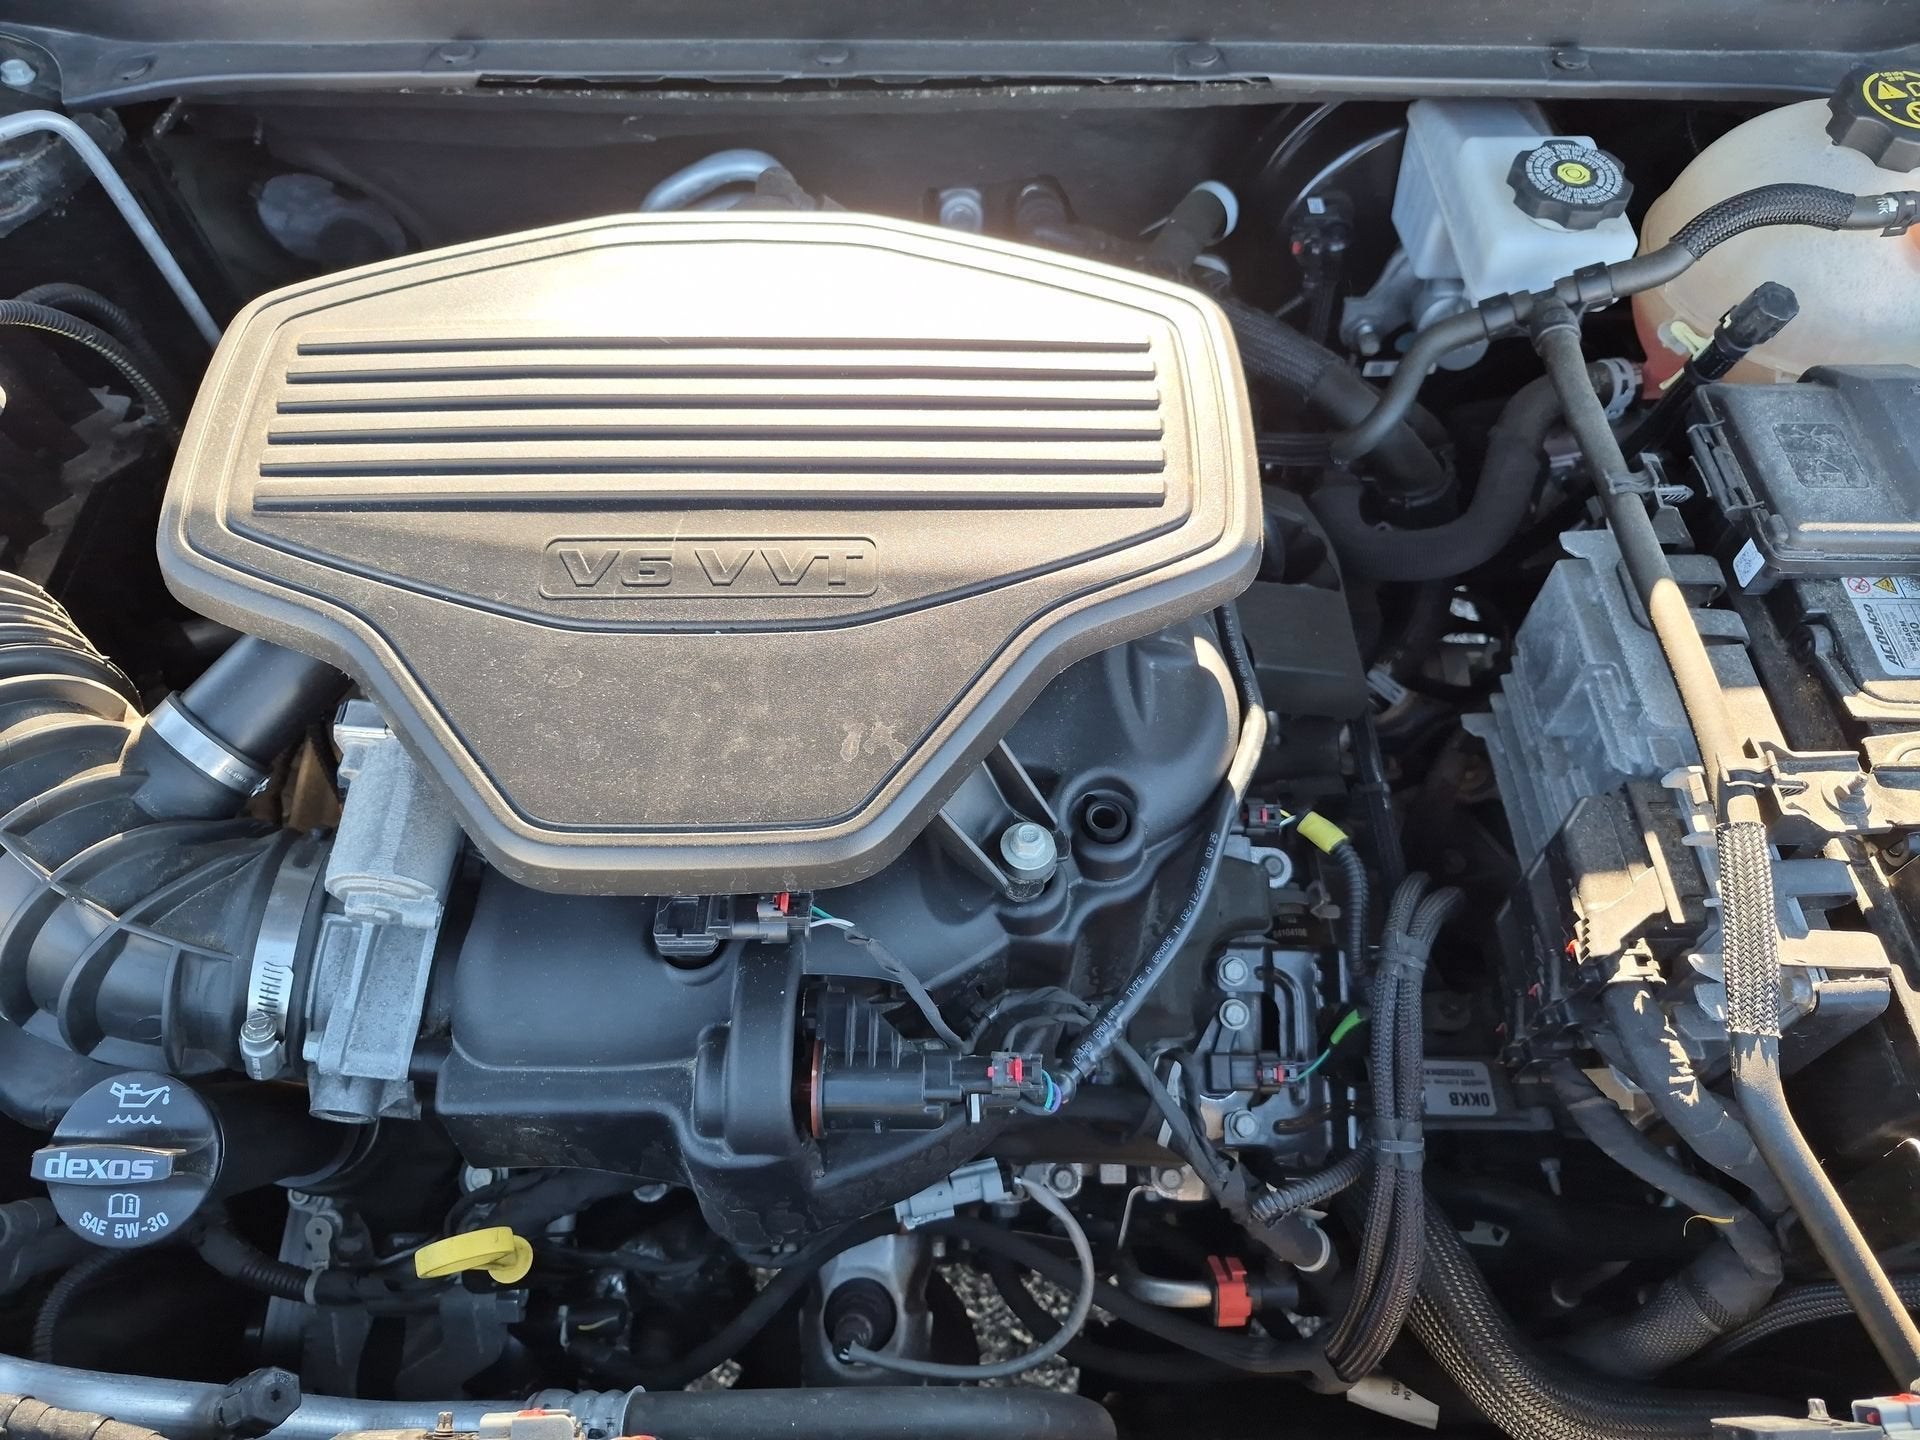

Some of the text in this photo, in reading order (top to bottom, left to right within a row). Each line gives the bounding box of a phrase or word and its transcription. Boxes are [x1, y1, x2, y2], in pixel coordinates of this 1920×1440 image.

[557, 547, 865, 588] V6 VVT
[1863, 603, 1900, 667] ACDelco
[1125, 974, 1146, 998] TYPE
[1144, 965, 1153, 975] A
[1151, 935, 1175, 964] GRADE
[1172, 924, 1182, 935] N
[44, 1151, 155, 1180] dexos
[79, 1211, 170, 1240] SAE 5W-30
